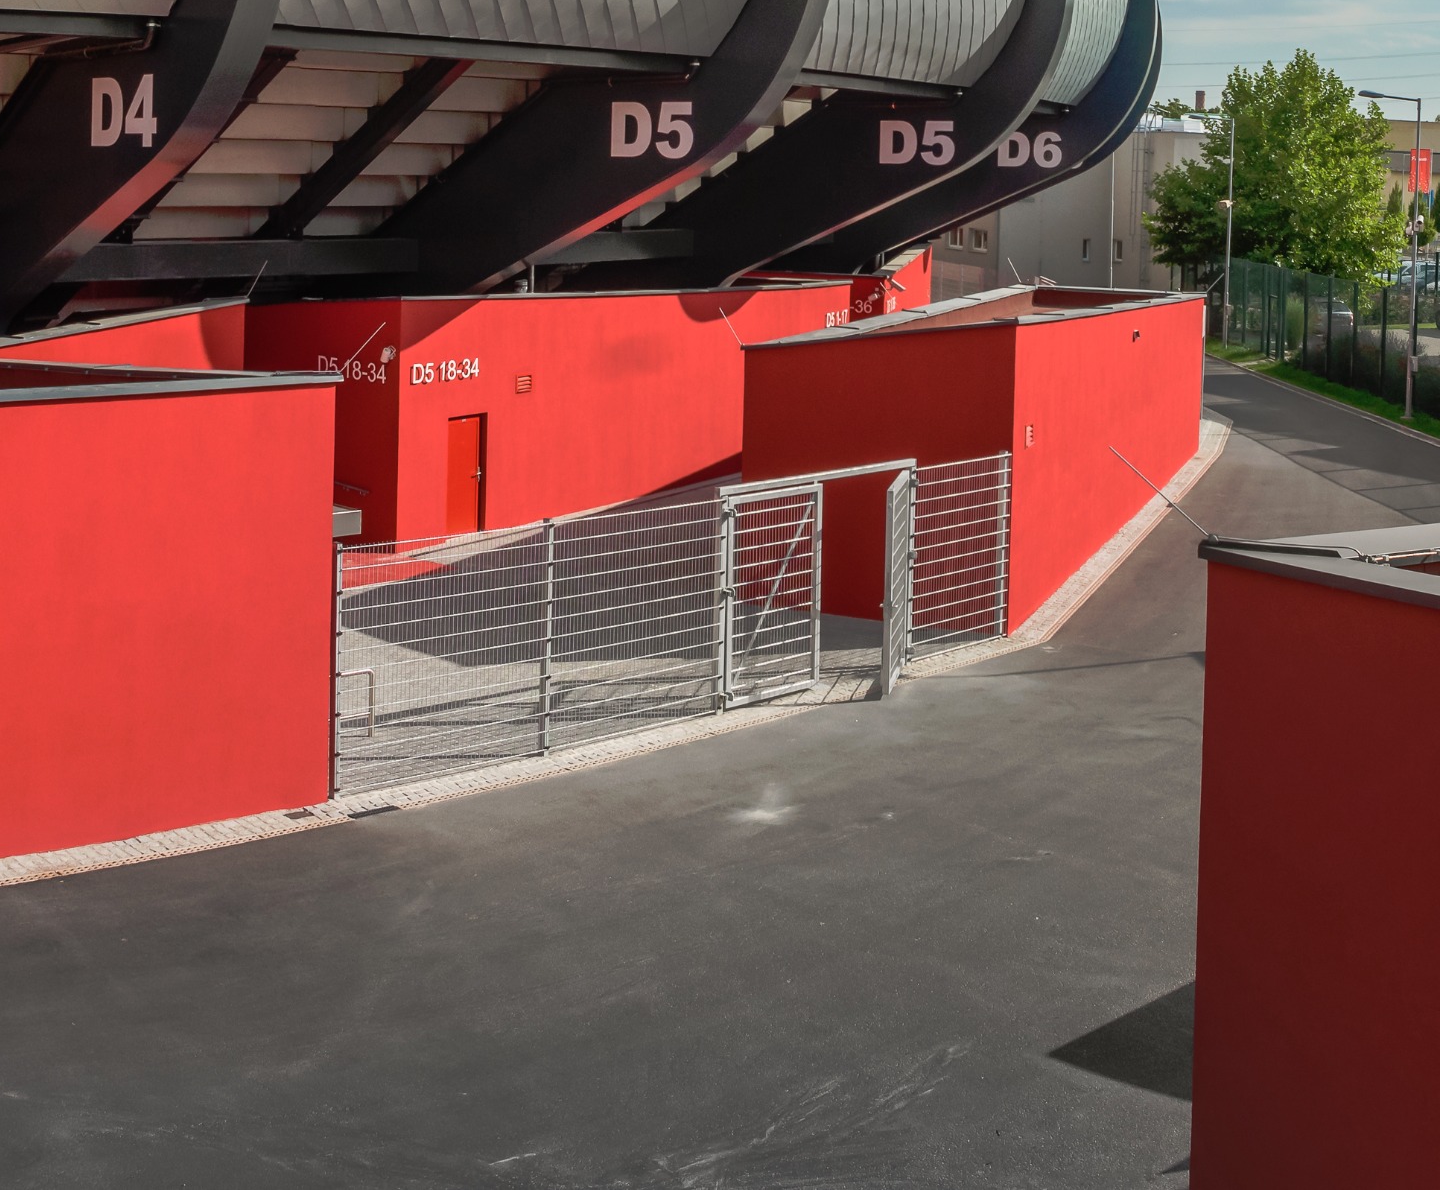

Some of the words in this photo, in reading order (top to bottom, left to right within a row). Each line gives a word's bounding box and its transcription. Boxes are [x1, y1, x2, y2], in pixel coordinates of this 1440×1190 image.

[91, 74, 157, 147] D4
[610, 101, 694, 159] D5
[879, 120, 956, 166] D5
[997, 132, 1063, 168] D6
[318, 355, 338, 373] D5
[345, 359, 386, 384] 18-34
[412, 363, 434, 384] D5
[439, 357, 479, 381] 18-34
